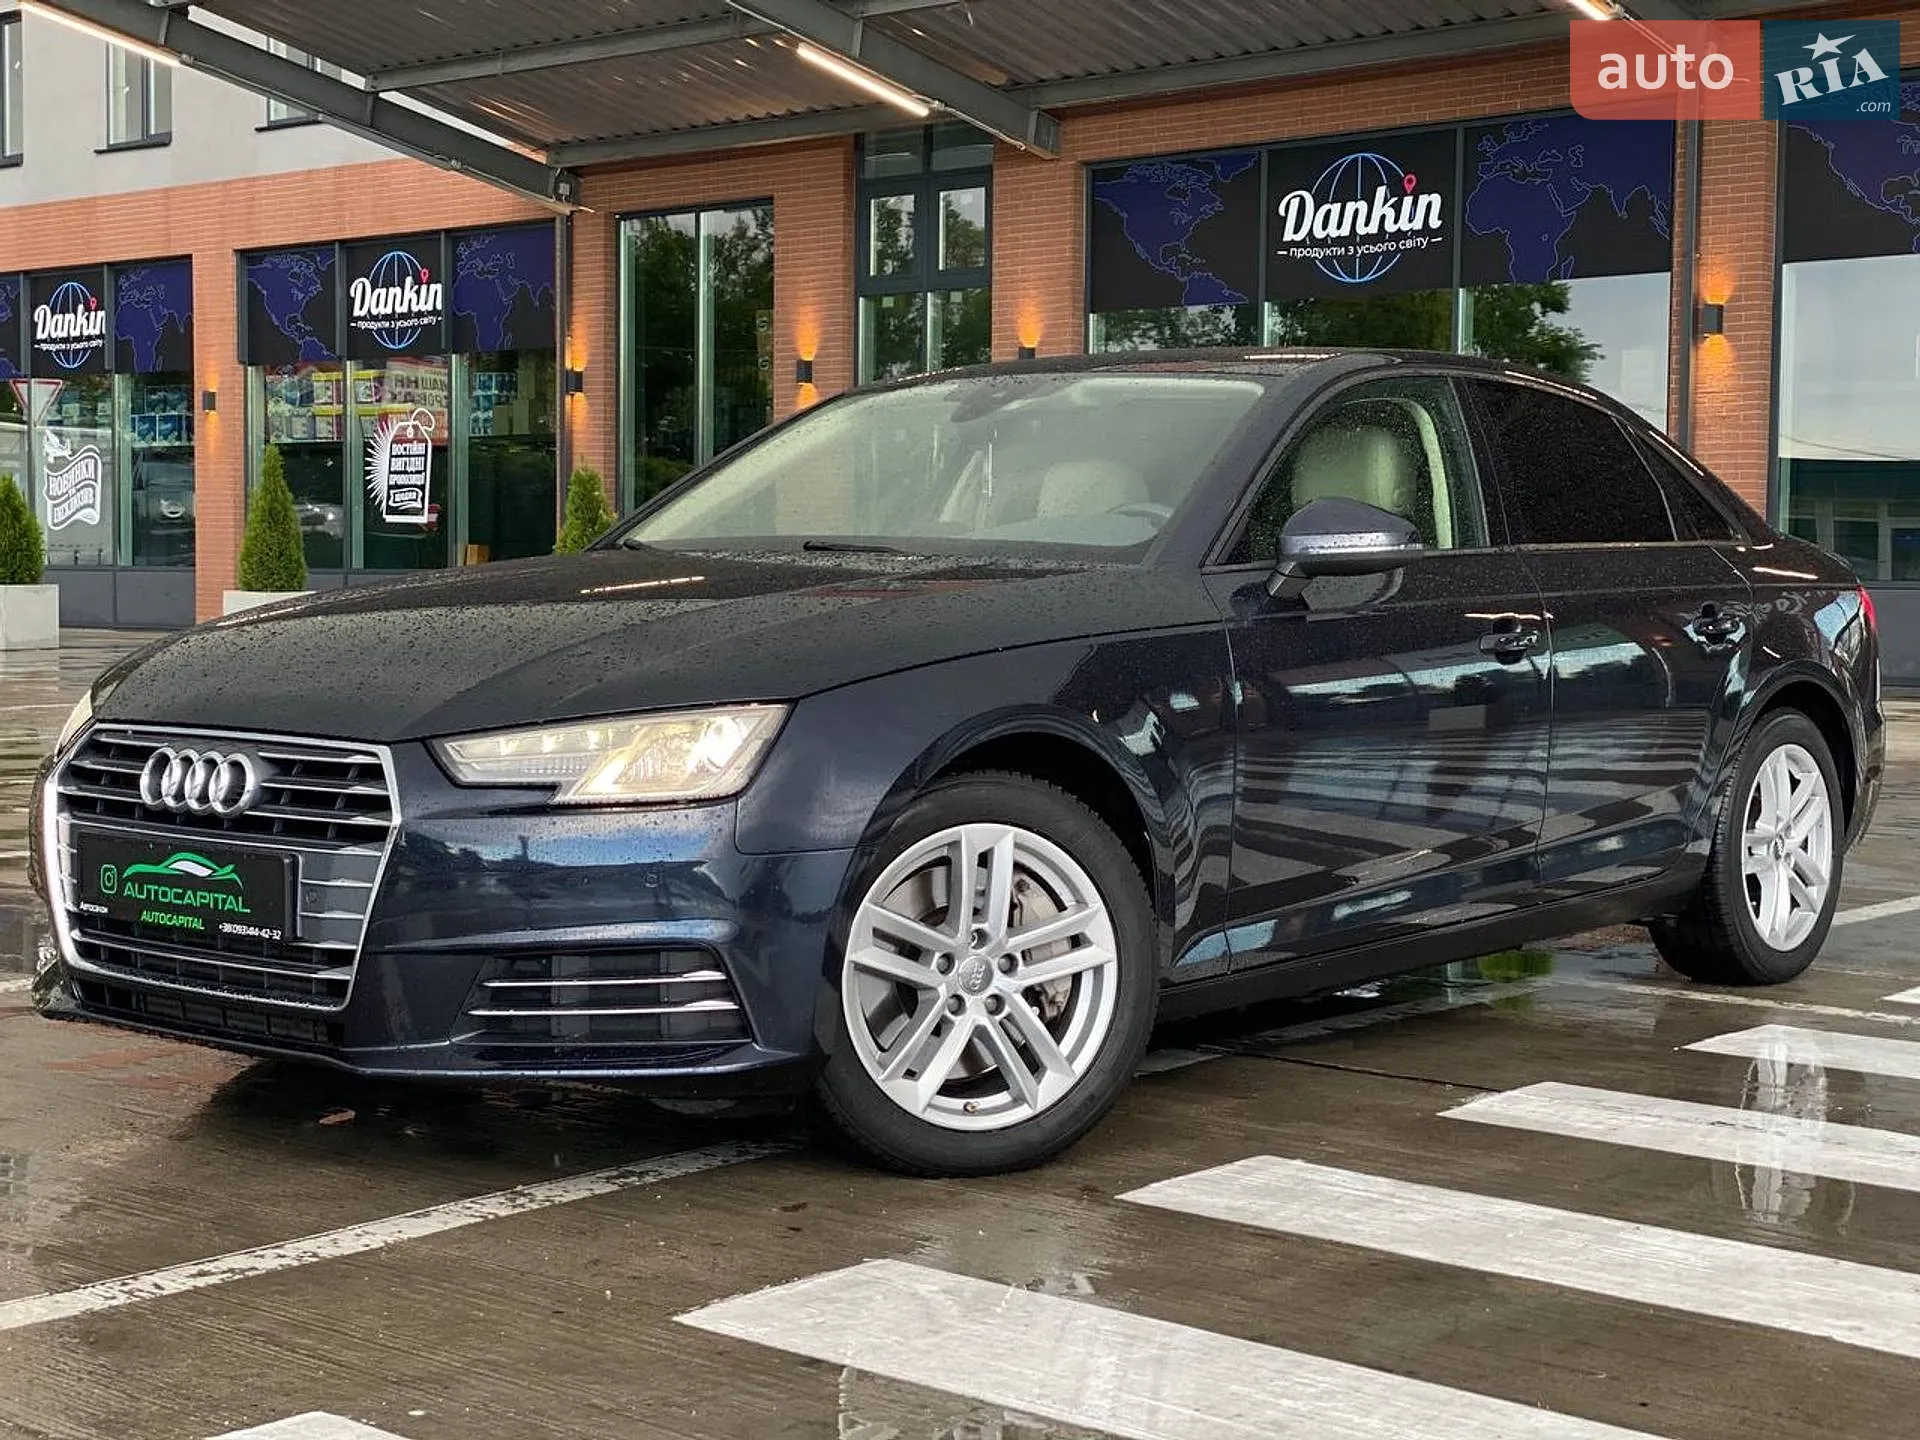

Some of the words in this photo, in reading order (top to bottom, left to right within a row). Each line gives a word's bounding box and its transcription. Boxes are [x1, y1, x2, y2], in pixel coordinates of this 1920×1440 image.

[1278, 184, 1442, 242] Dankin
[1289, 246, 1345, 260] продукти
[1347, 245, 1355, 256] з
[1356, 241, 1397, 258] усього
[1398, 235, 1430, 250] світу
[349, 275, 442, 317] Dankin
[34, 303, 106, 340] Dankin
[49, 458, 95, 497] НОВИНКИ
[123, 881, 252, 913] AUTOCAPITAL
[140, 910, 205, 930] AUTOCAPITAL
